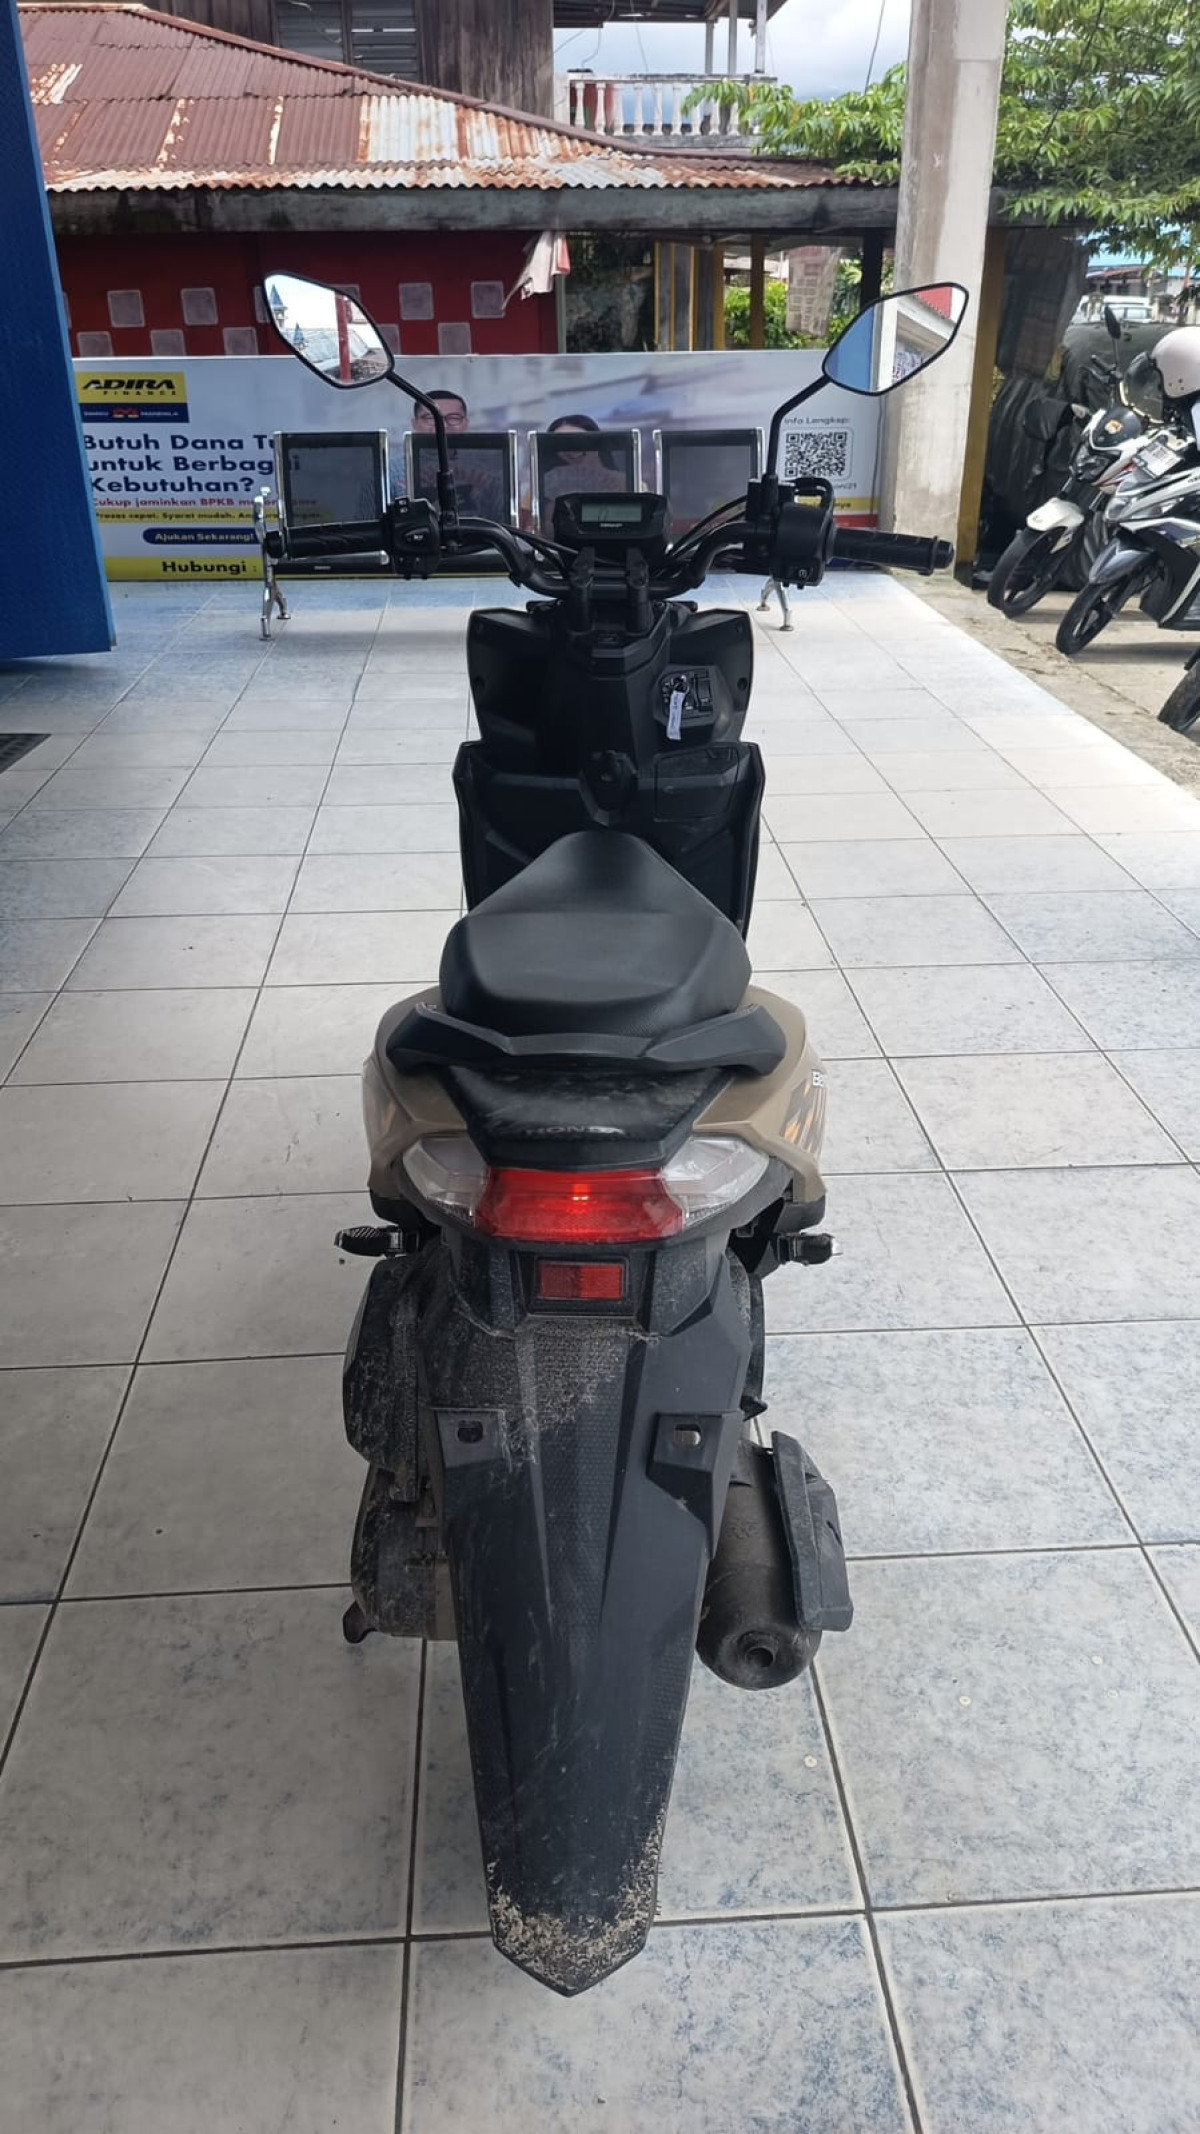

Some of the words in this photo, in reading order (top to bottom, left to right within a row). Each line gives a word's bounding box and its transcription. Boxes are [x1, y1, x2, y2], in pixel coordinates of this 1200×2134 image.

[83, 379, 175, 390] ADIRA
[84, 433, 160, 450] Butuh
[170, 434, 244, 450] Dana
[92, 476, 254, 492] Kebutuhan?
[135, 498, 197, 508] jaminkan
[201, 498, 234, 506] BPKB
[155, 533, 195, 542] Ajukan
[197, 533, 255, 542] Sekarang!
[162, 561, 247, 575] Hubungi
